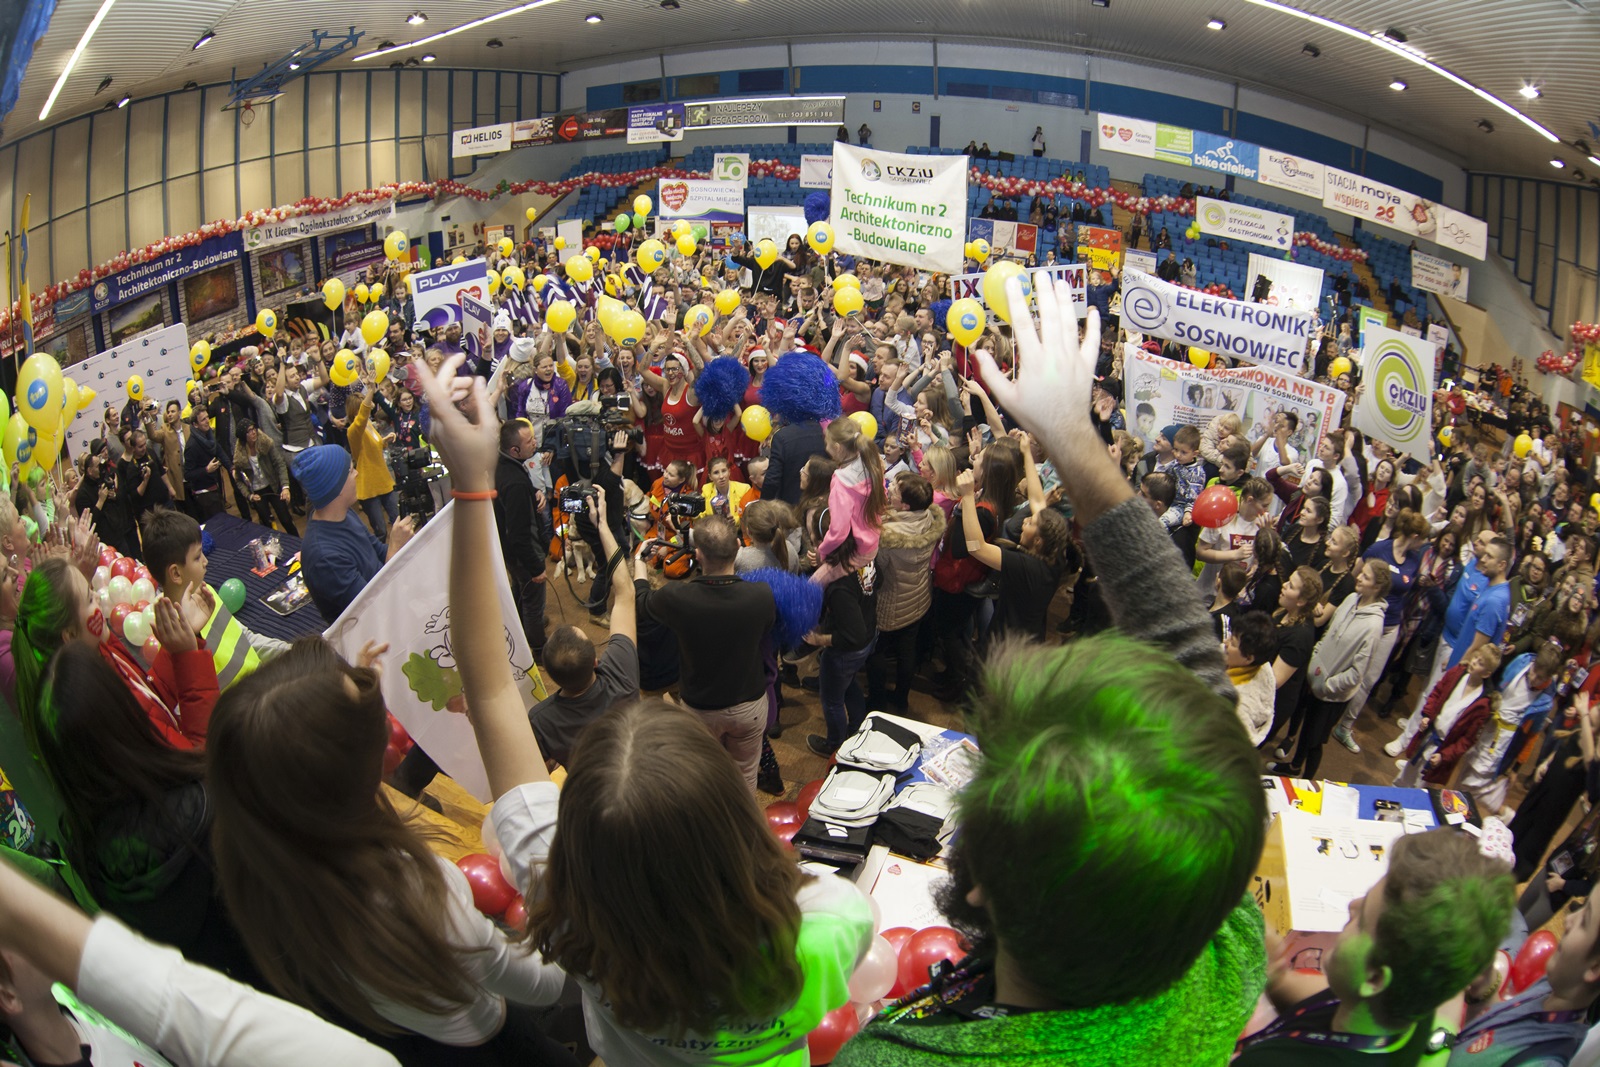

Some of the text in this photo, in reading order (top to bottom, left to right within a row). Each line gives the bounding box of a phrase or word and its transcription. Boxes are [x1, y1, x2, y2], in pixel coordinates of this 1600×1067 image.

[711, 113, 769, 125] ESCAPE ROOM
[715, 102, 764, 113] NAJLEPSZY
[473, 130, 502, 143] HELIOS
[886, 165, 934, 178] CKZiU
[1194, 153, 1219, 168] bike
[1219, 161, 1257, 178] atelier
[1327, 172, 1358, 192] STACJA
[1361, 184, 1402, 205] moya
[844, 188, 948, 217] Technikum nr 2
[1334, 192, 1395, 219] wspiera 26
[265, 228, 273, 239] IX
[275, 225, 298, 238] Liceum
[840, 206, 953, 239] Architektoniczno
[1228, 217, 1266, 230] STYLIZACJA
[1228, 226, 1273, 241] GASTRONOMIA
[847, 227, 927, 255] -Budowlane
[116, 252, 182, 286] Technikum nr 2
[118, 249, 238, 300] Architektoniczno-Budowlane
[419, 271, 459, 290] PLAY
[953, 277, 981, 300] IX
[463, 300, 481, 316] PLAY
[1176, 291, 1307, 337] ELEKTRONIK
[1174, 321, 1300, 369] SOSNOWIEC
[1272, 388, 1313, 406] SOSNOWCU
[1292, 381, 1315, 398] NR
[1319, 390, 1336, 405] 18
